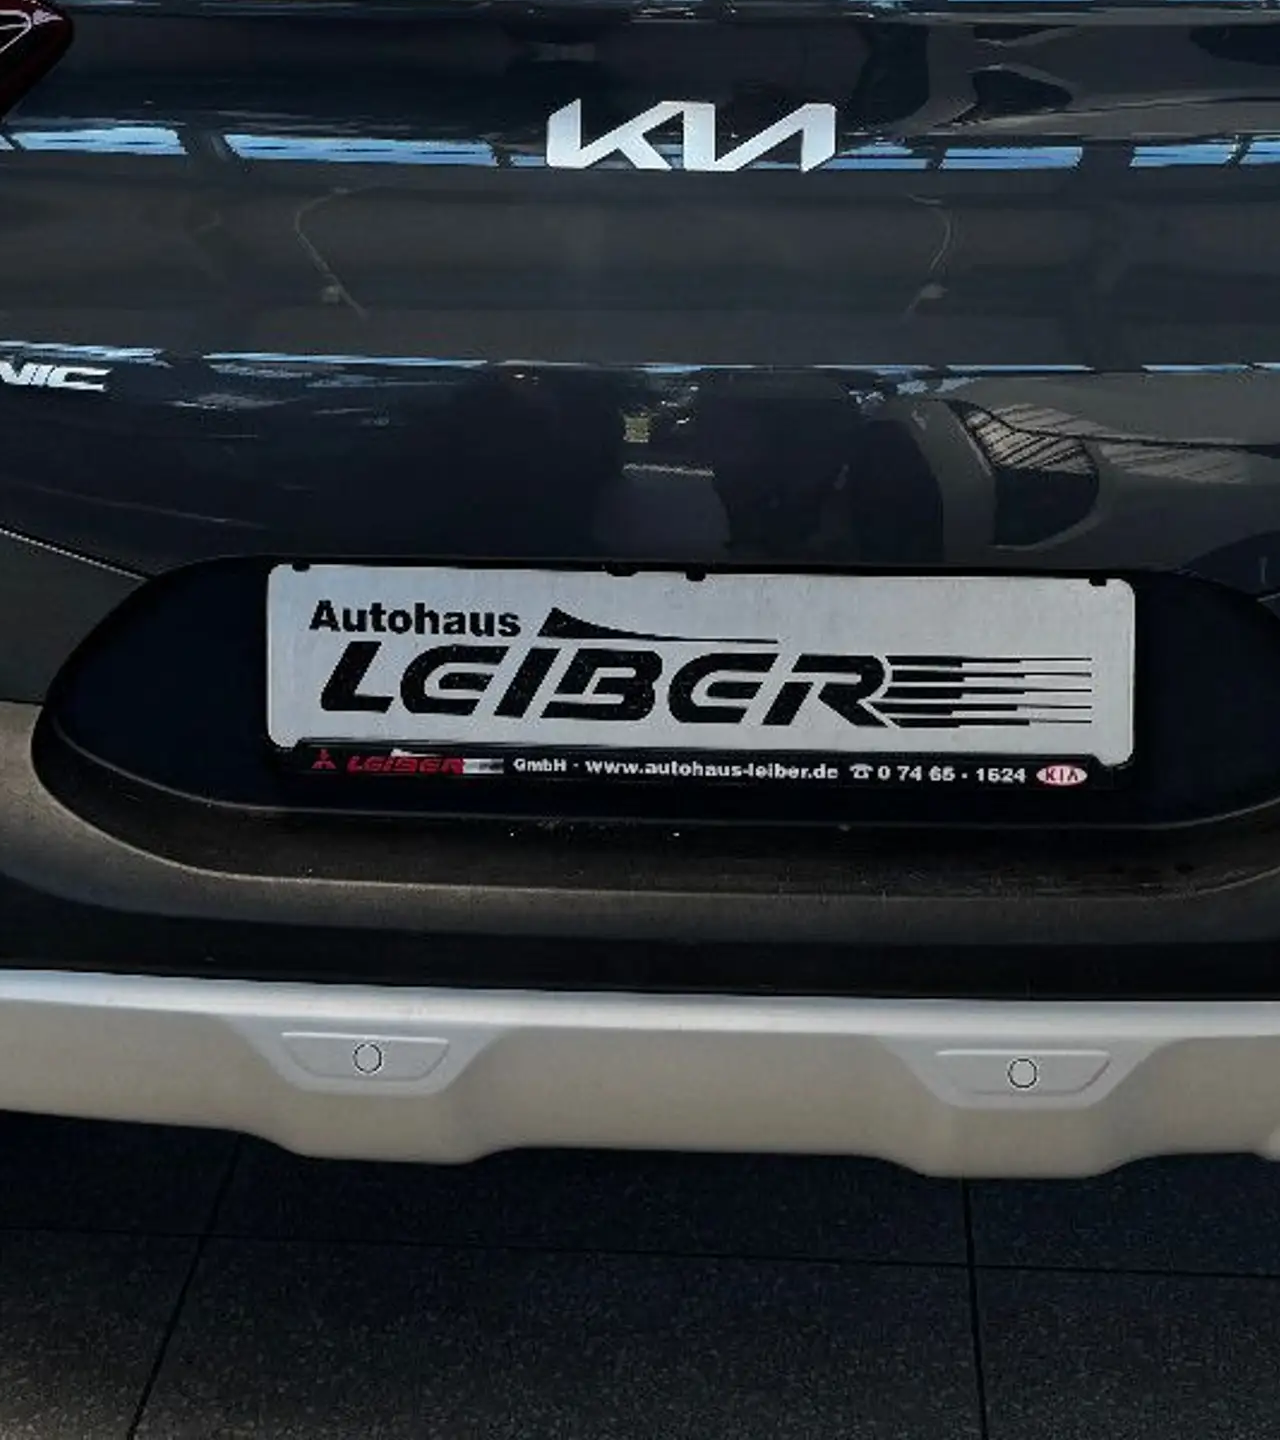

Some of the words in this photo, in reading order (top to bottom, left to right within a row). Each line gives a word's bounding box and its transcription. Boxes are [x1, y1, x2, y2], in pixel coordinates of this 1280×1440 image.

[546, 98, 836, 172] KIA
[309, 599, 521, 637] Autohaus
[320, 640, 890, 728] LEIBER
[513, 759, 567, 773] GmbH
[585, 760, 839, 779] www.autohaus-leiber.de
[877, 765, 891, 780] 0
